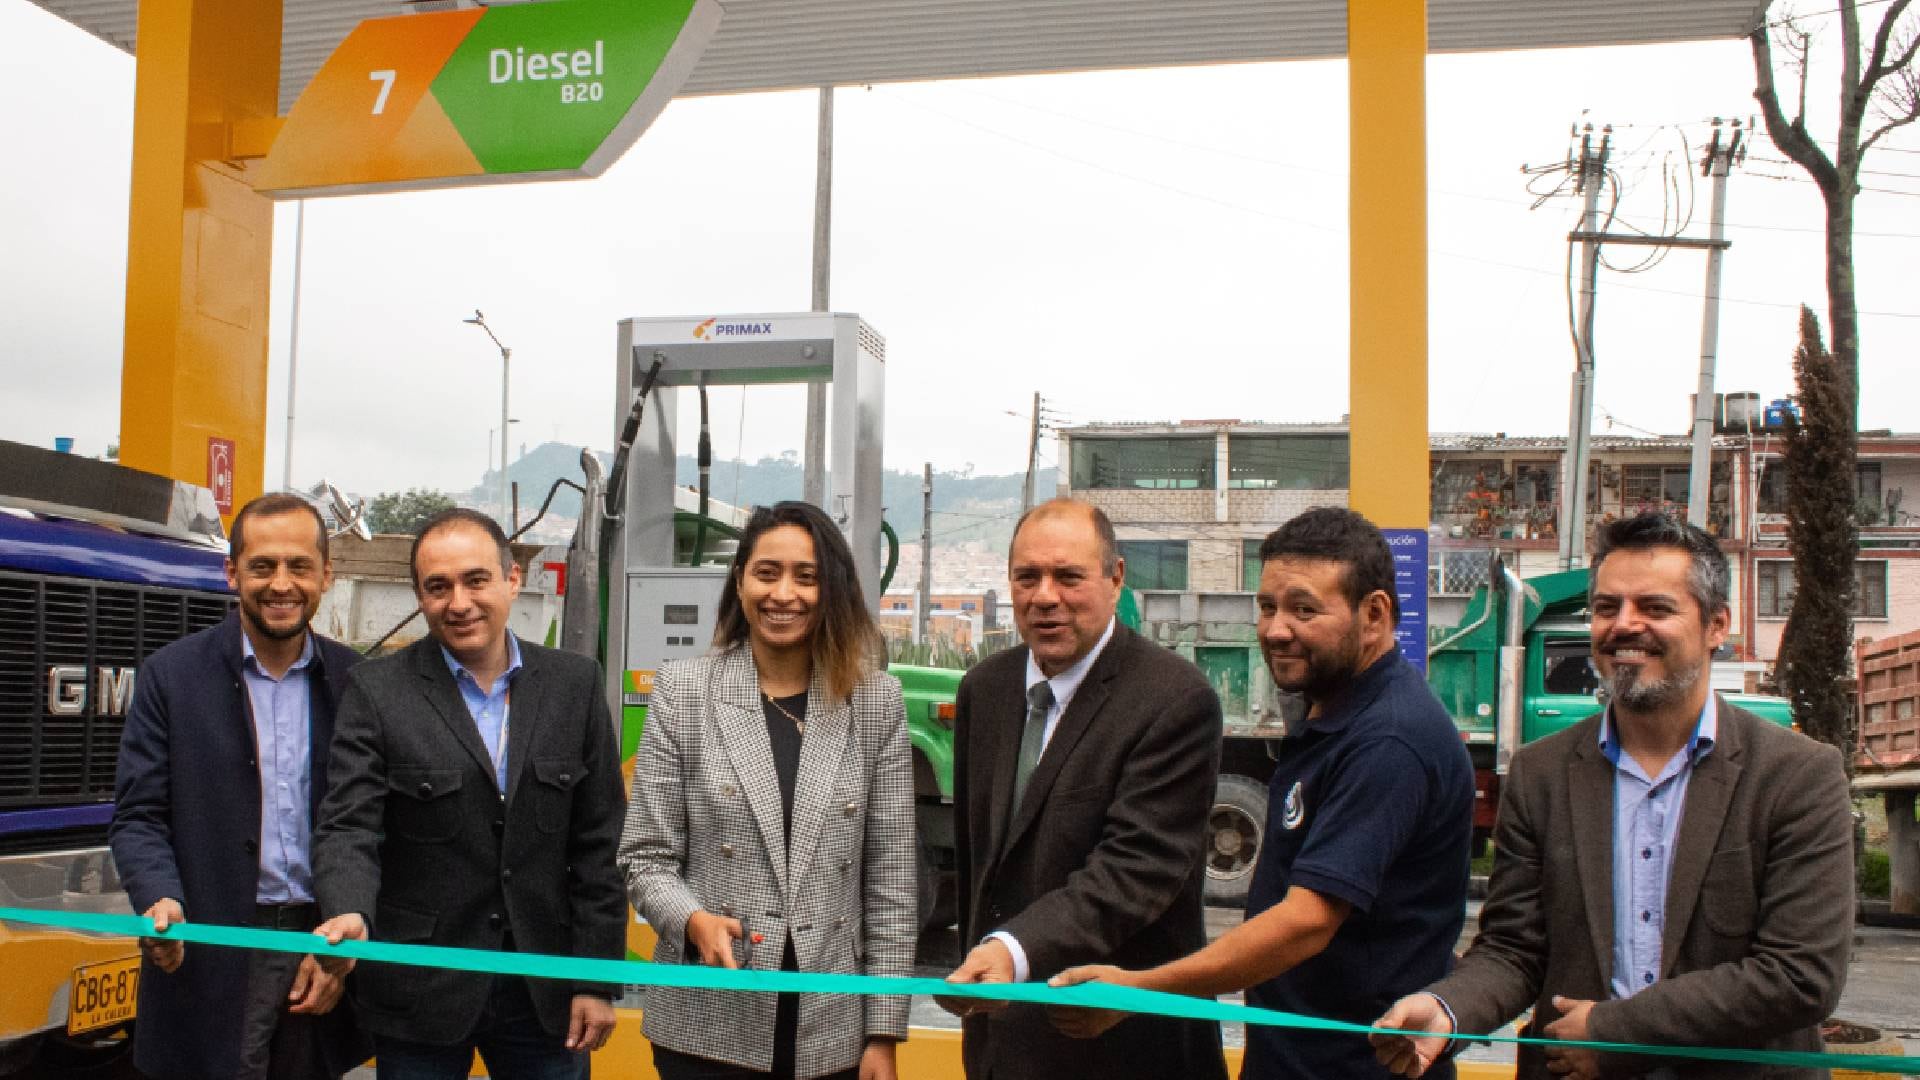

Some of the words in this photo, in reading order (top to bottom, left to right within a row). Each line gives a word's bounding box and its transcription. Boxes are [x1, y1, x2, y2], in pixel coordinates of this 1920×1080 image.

[489, 40, 604, 84] Diesel
[370, 69, 396, 114] 7
[561, 83, 603, 103] B20
[716, 323, 771, 336] PRIMAX
